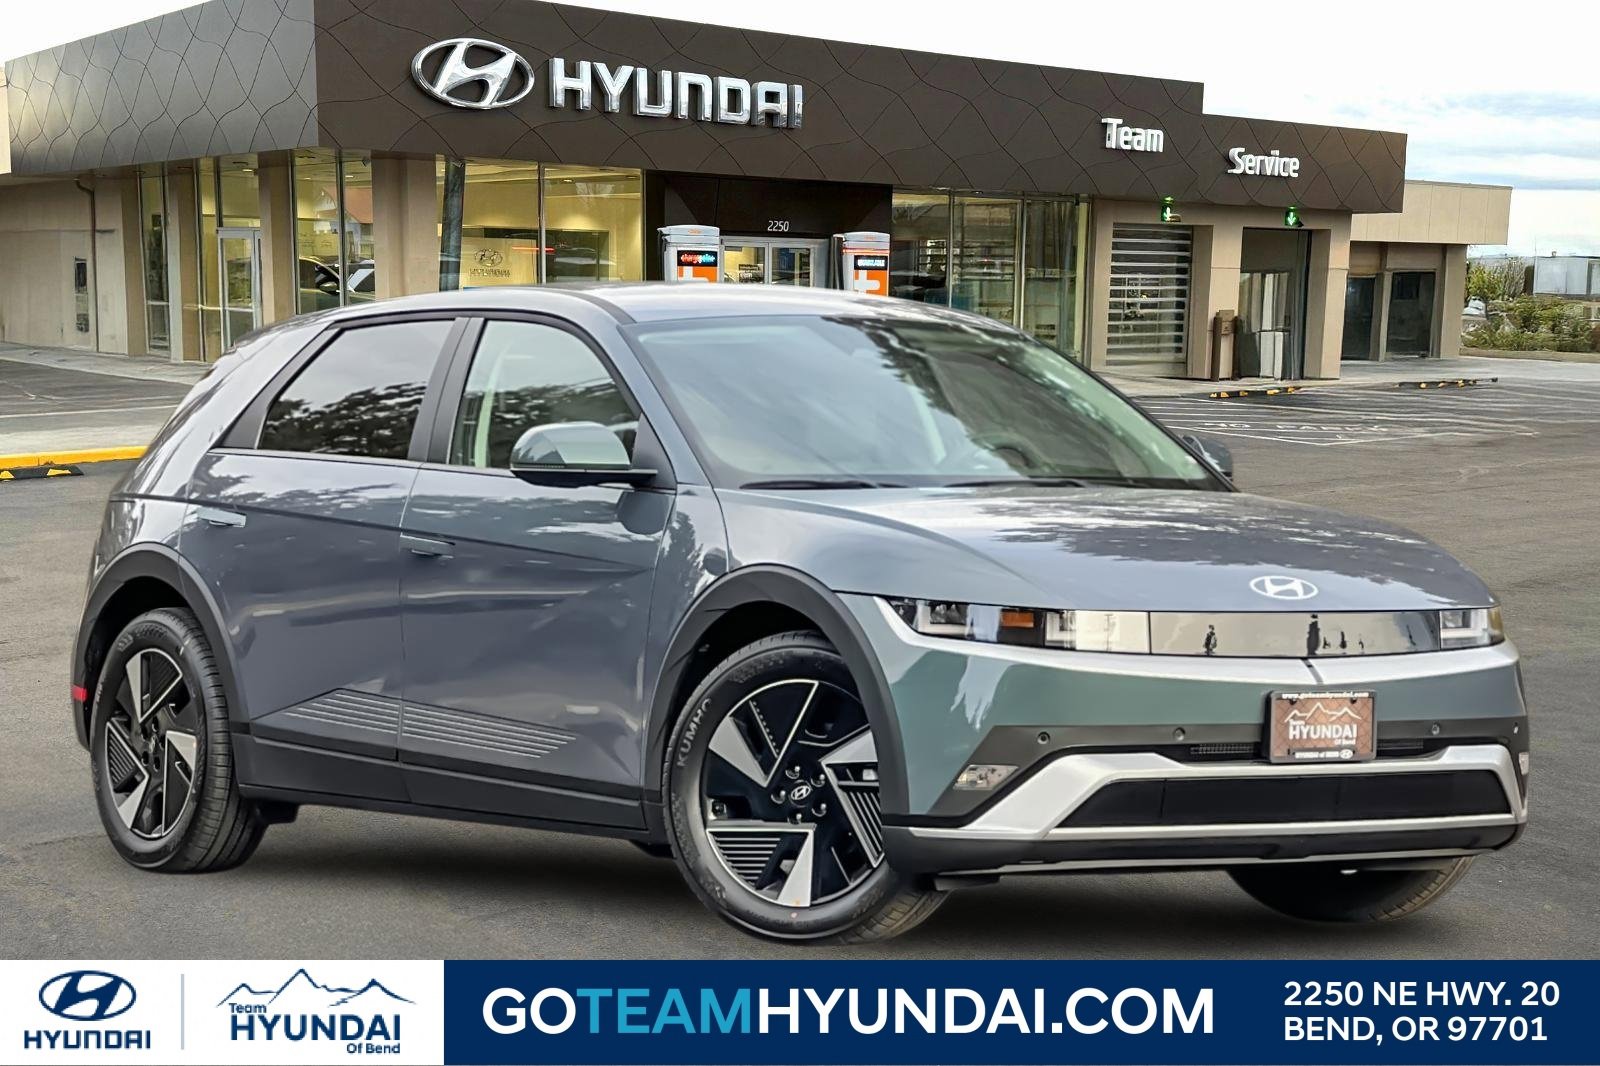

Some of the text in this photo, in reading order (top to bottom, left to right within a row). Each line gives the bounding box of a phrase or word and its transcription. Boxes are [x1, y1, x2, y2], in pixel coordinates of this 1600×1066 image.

[549, 57, 804, 129] HYUNDAI
[1101, 118, 1165, 153] Team
[1227, 147, 1300, 177] Service
[767, 220, 790, 232] 2250
[677, 698, 711, 767] KUMHO
[1288, 723, 1358, 740] HYUNDAI
